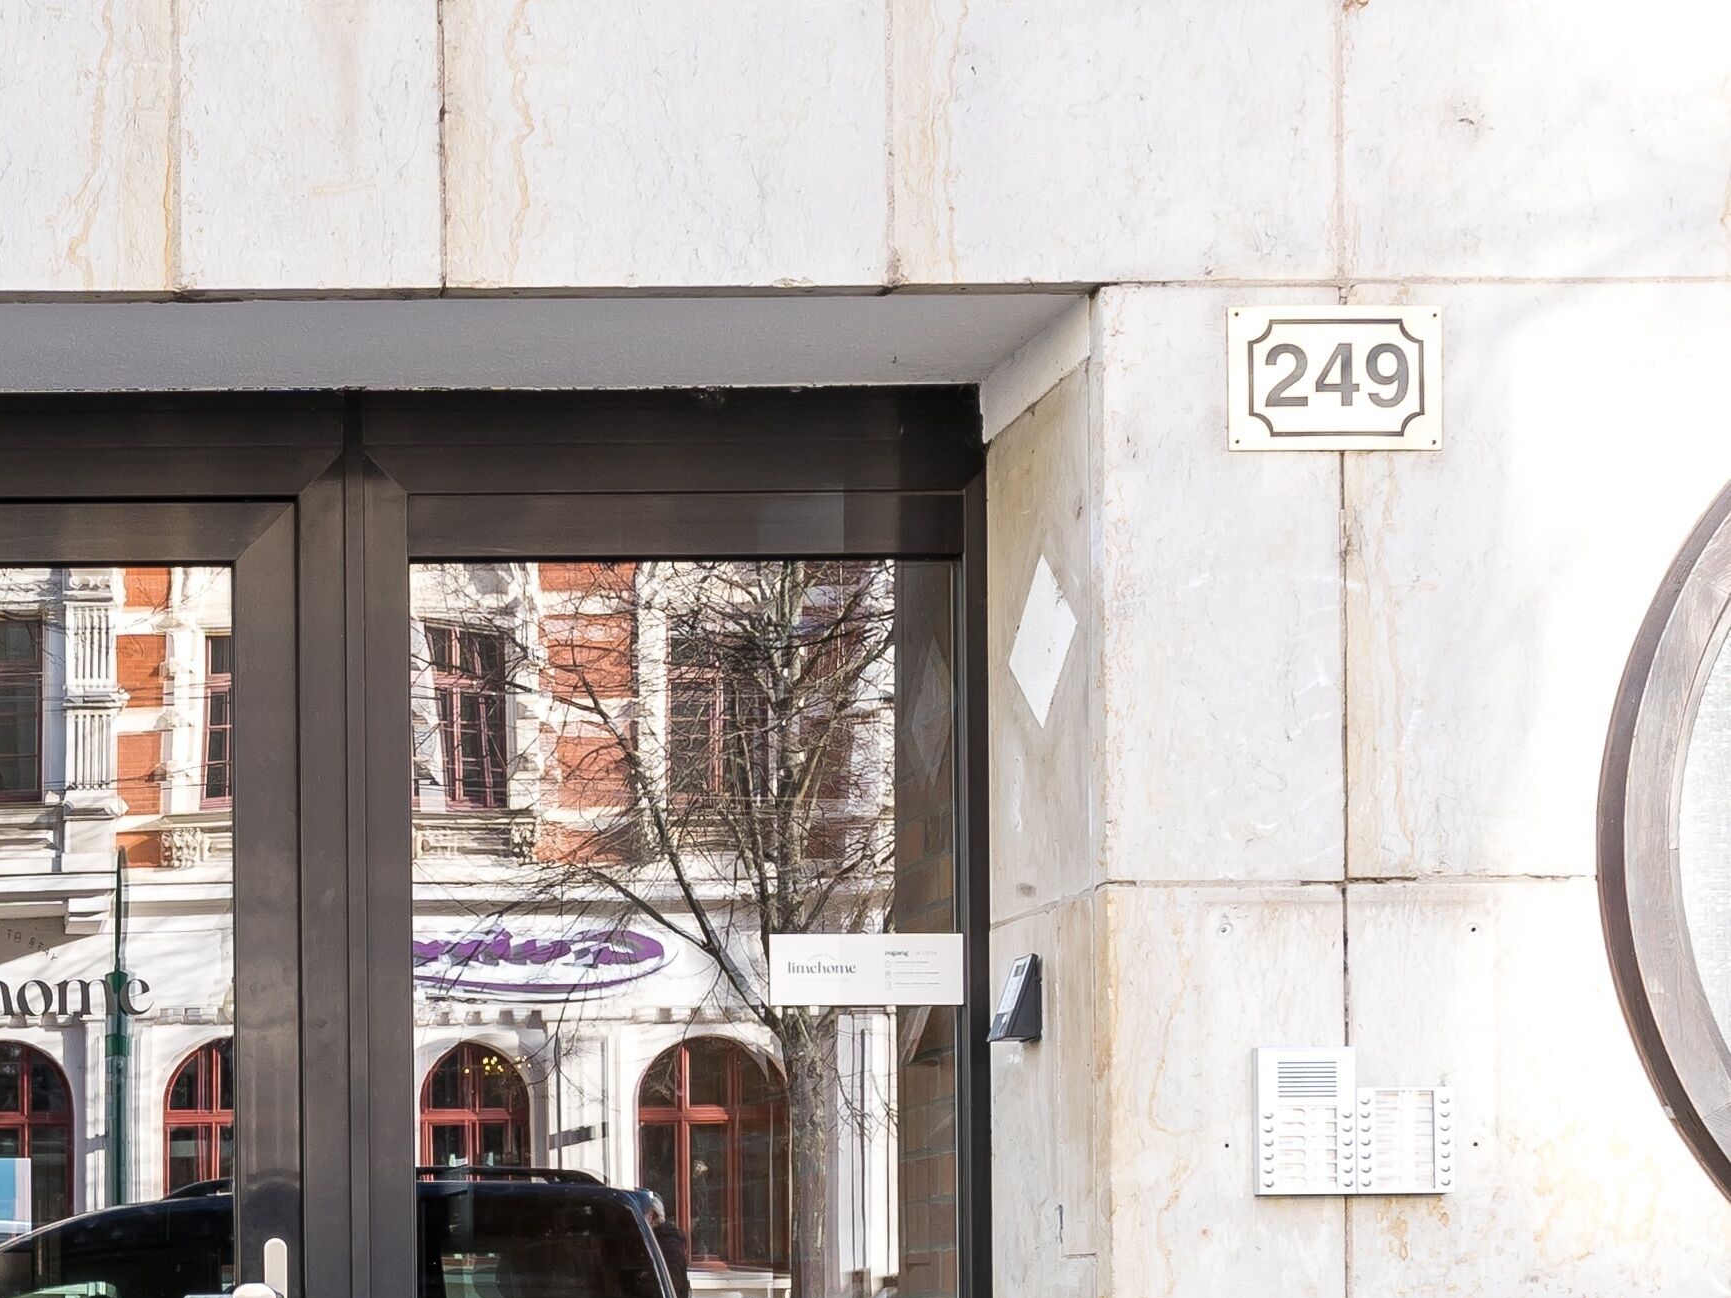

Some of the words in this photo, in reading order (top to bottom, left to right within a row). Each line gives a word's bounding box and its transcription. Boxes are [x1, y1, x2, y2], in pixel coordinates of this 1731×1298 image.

[1265, 342, 1410, 408] 249
[6, 928, 24, 943] TO
[787, 961, 857, 975] limehome
